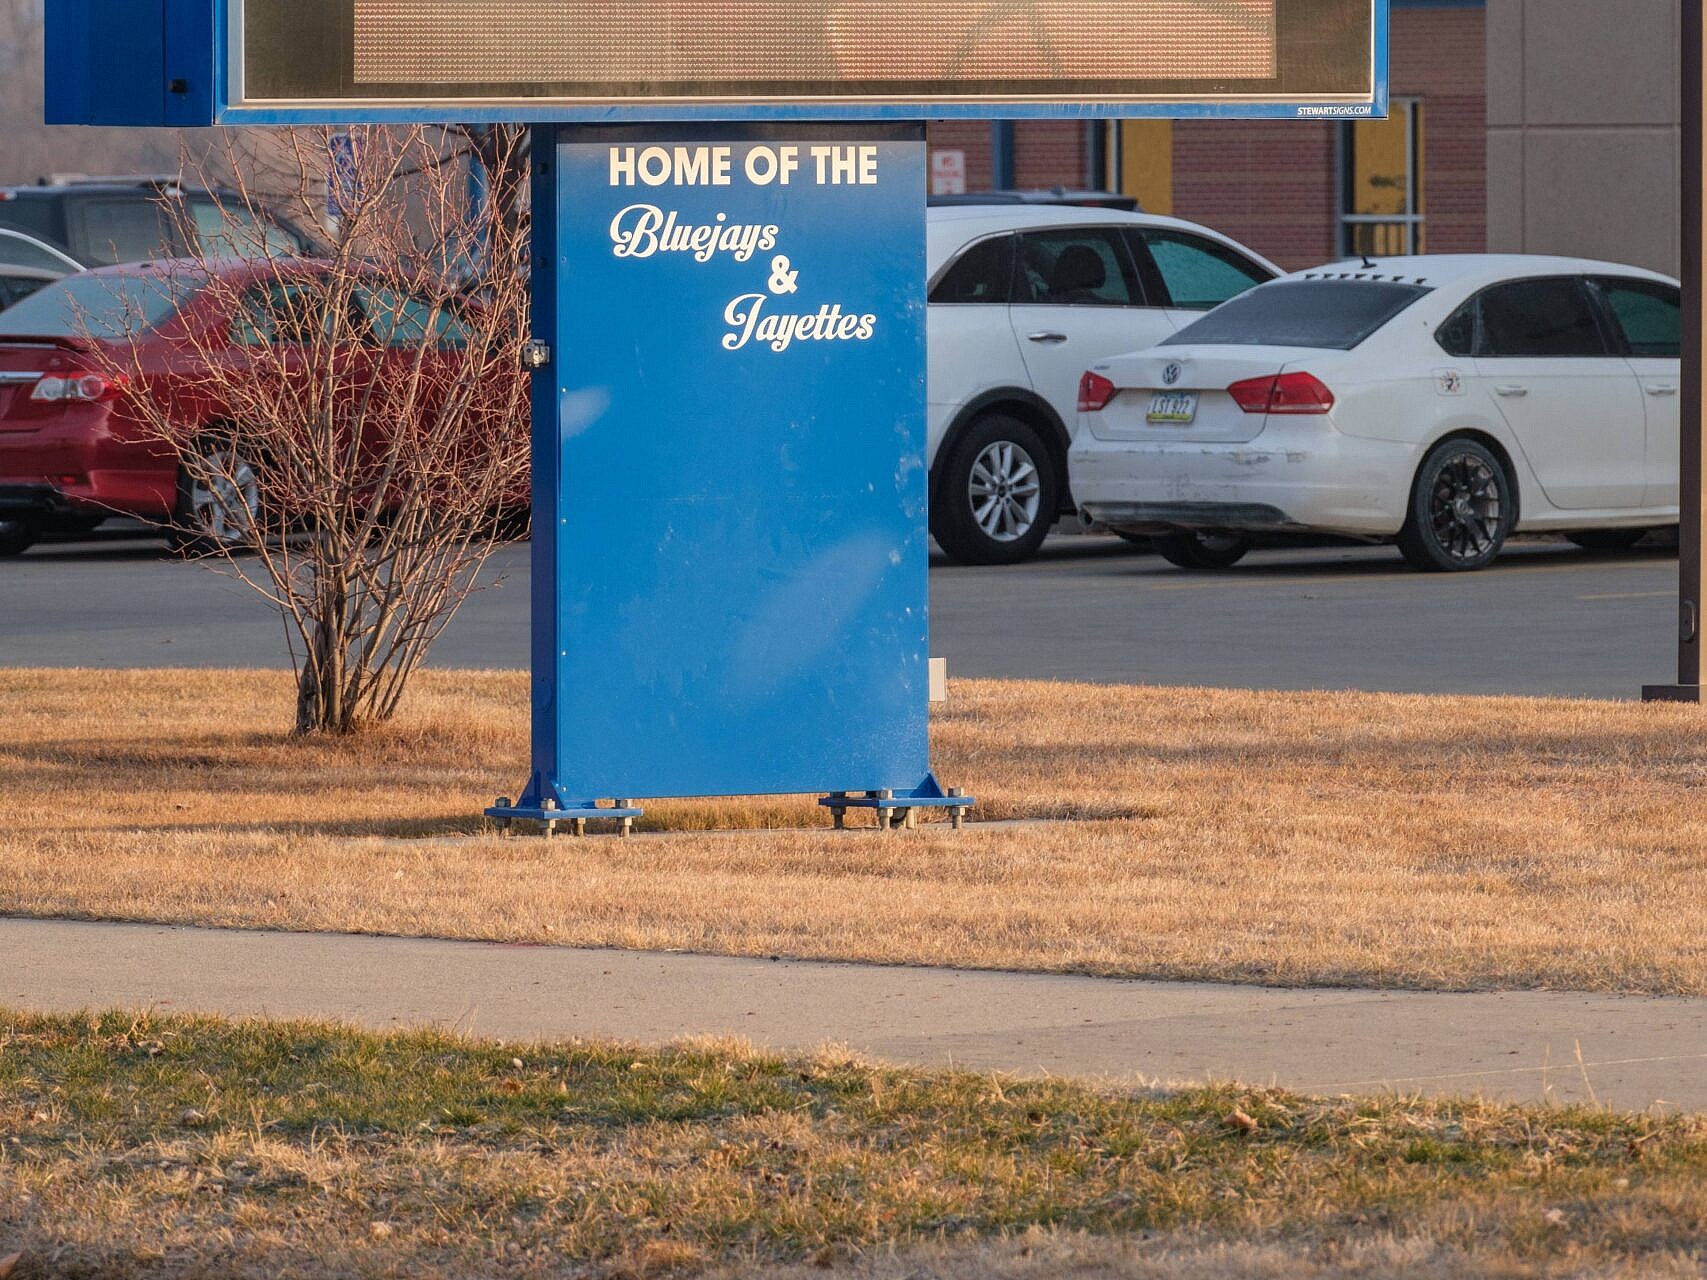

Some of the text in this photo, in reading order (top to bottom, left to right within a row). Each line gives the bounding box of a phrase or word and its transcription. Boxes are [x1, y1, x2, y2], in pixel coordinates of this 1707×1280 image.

[1296, 106, 1372, 116] STEWARTSIGNS.COM
[608, 145, 878, 186] HOME OF THE
[609, 203, 779, 263] Bluejays
[767, 254, 800, 295] &
[721, 293, 877, 353] Jayettes
